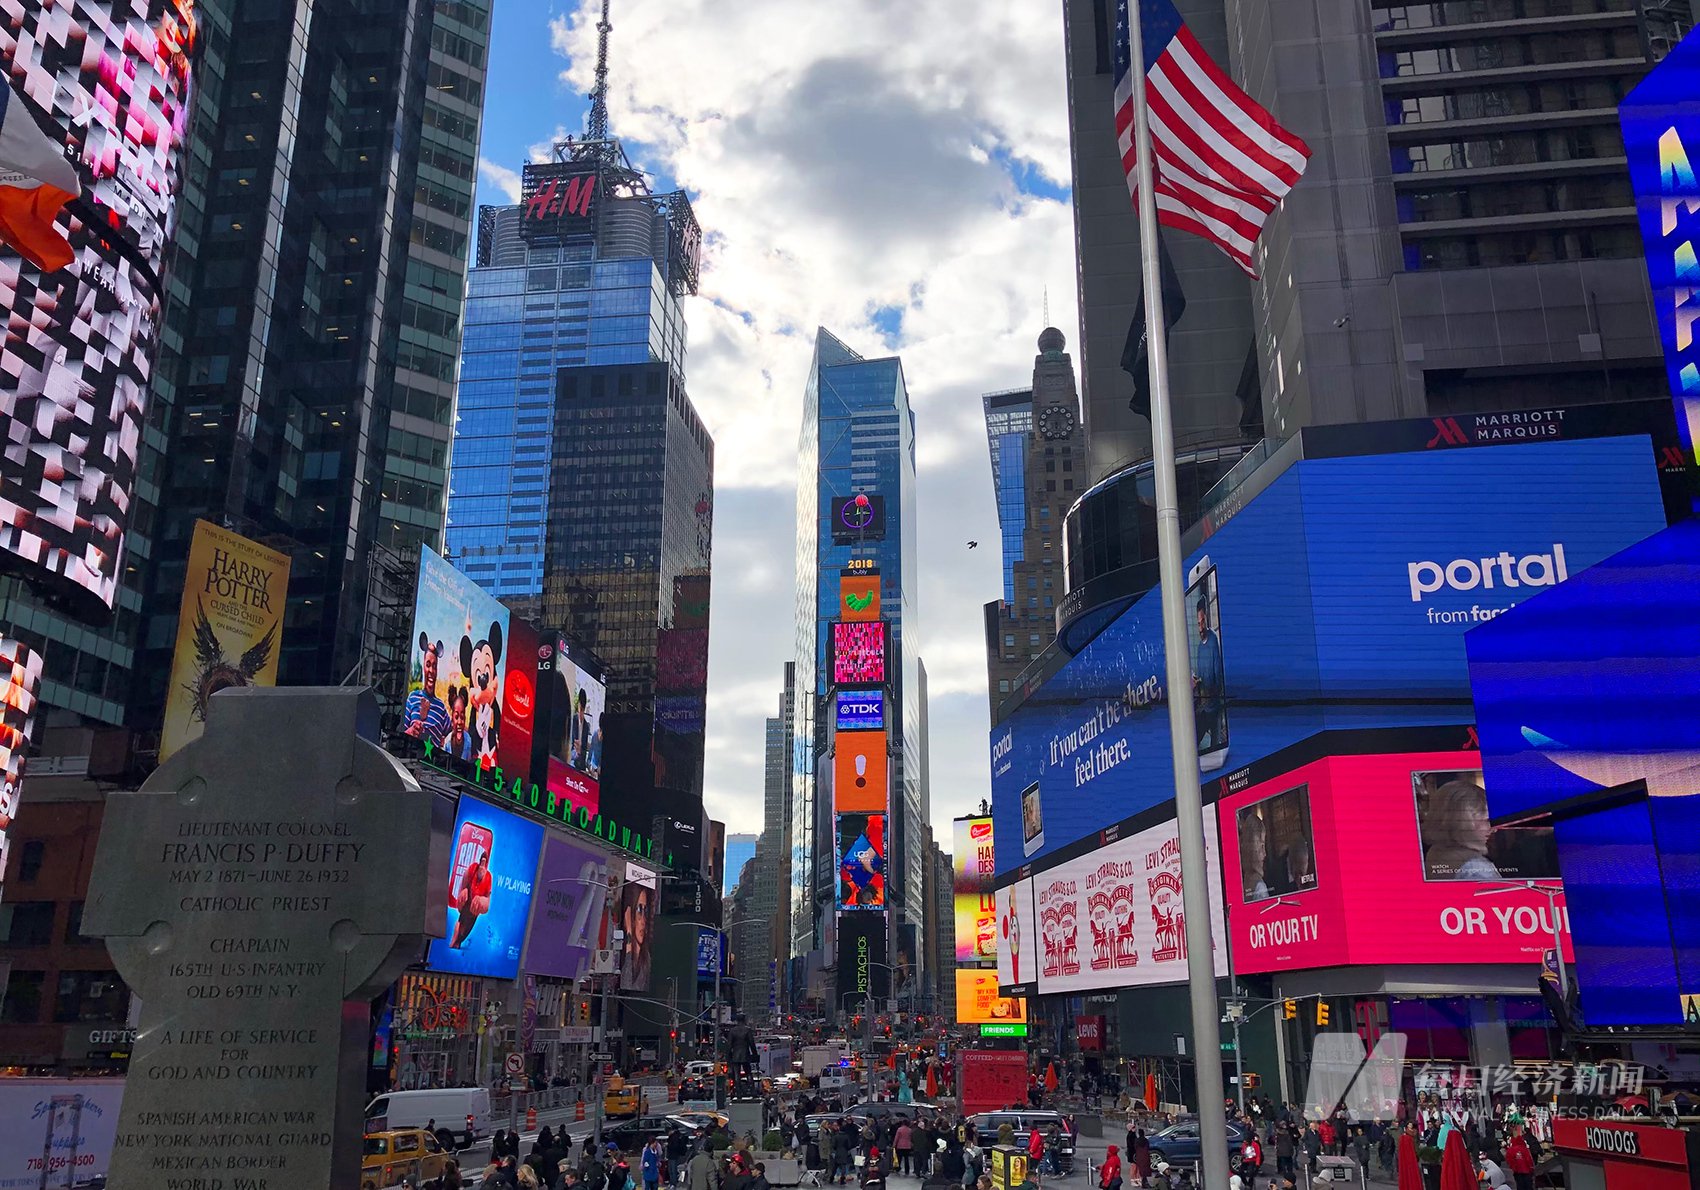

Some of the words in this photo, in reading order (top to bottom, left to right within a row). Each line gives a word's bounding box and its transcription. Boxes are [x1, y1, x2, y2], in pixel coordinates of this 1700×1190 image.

[525, 175, 596, 220] H&M
[1475, 410, 1565, 426] MARRIOTT
[1477, 425, 1557, 440] MARQUIS
[213, 547, 273, 590] HARRY
[848, 560, 873, 569] 2018
[1407, 543, 1568, 602] portal
[205, 568, 272, 614] POTTER
[210, 599, 239, 616] CURSED
[241, 610, 264, 626] CHILD
[1426, 608, 1468, 624] from
[538, 662, 550, 670] LG
[850, 704, 879, 713] TDK
[1050, 735, 1058, 766] If
[1059, 731, 1077, 767] you
[1078, 706, 1104, 747] can't
[1105, 700, 1121, 728] be
[1122, 675, 1162, 717] there,
[993, 727, 1012, 767] portal
[1075, 749, 1095, 788] feel
[1096, 738, 1131, 775] there.
[1228, 767, 1250, 782] MARRIOTT
[1230, 778, 1248, 790] MARQUIS
[475, 759, 539, 807] 1540
[546, 791, 653, 859] BROADWAY
[179, 822, 271, 837] LIEUTENANT
[277, 822, 351, 836] COLONEL
[161, 843, 255, 863] FRANCIS
[287, 843, 367, 862] DUFFY
[1145, 851, 1159, 870] LEVI
[169, 870, 201, 883] MAY
[204, 870, 213, 883] 2
[297, 870, 313, 883] 26
[317, 870, 349, 883] 1932
[1085, 873, 1097, 889] LEVI
[1097, 862, 1119, 884] STRAUSS
[504, 876, 531, 895] PLAYING
[180, 897, 263, 911] CATHOLIC
[272, 897, 331, 911] PRIEST
[1440, 907, 1488, 935] OR
[1250, 924, 1266, 949] OR
[1266, 918, 1300, 946] YOUR
[1301, 914, 1318, 941] TV
[210, 939, 289, 952] CHAPLAIN
[170, 963, 213, 977] 165TH
[252, 963, 325, 977] INFANTRY
[857, 935, 867, 993] PISTACHIOS
[187, 985, 220, 999] OLD
[226, 985, 263, 999] 69TH
[89, 1030, 136, 1044] GIFTS
[161, 1030, 171, 1044] A
[180, 1030, 214, 1044] LIFE
[220, 1030, 244, 1044] OF
[250, 1030, 318, 1044] SERVICE
[220, 1050, 248, 1060] FOR
[149, 1066, 188, 1080] GOD
[193, 1066, 230, 1079] AND
[237, 1066, 319, 1079] COUNTRY
[138, 1111, 196, 1125] SPANISH
[200, 1111, 278, 1125] AMERICAN
[284, 1111, 316, 1125] WAR
[115, 1133, 149, 1148] NEW
[152, 1133, 192, 1148] YORK
[199, 1133, 272, 1148] NATIONAL
[278, 1133, 331, 1147] GUARD
[1585, 1126, 1636, 1154] HOTDOGS
[152, 1156, 220, 1170] MEXICAN
[226, 1156, 287, 1169] BORDER
[167, 1179, 222, 1190] WORLD
[234, 1179, 267, 1190] WAR
